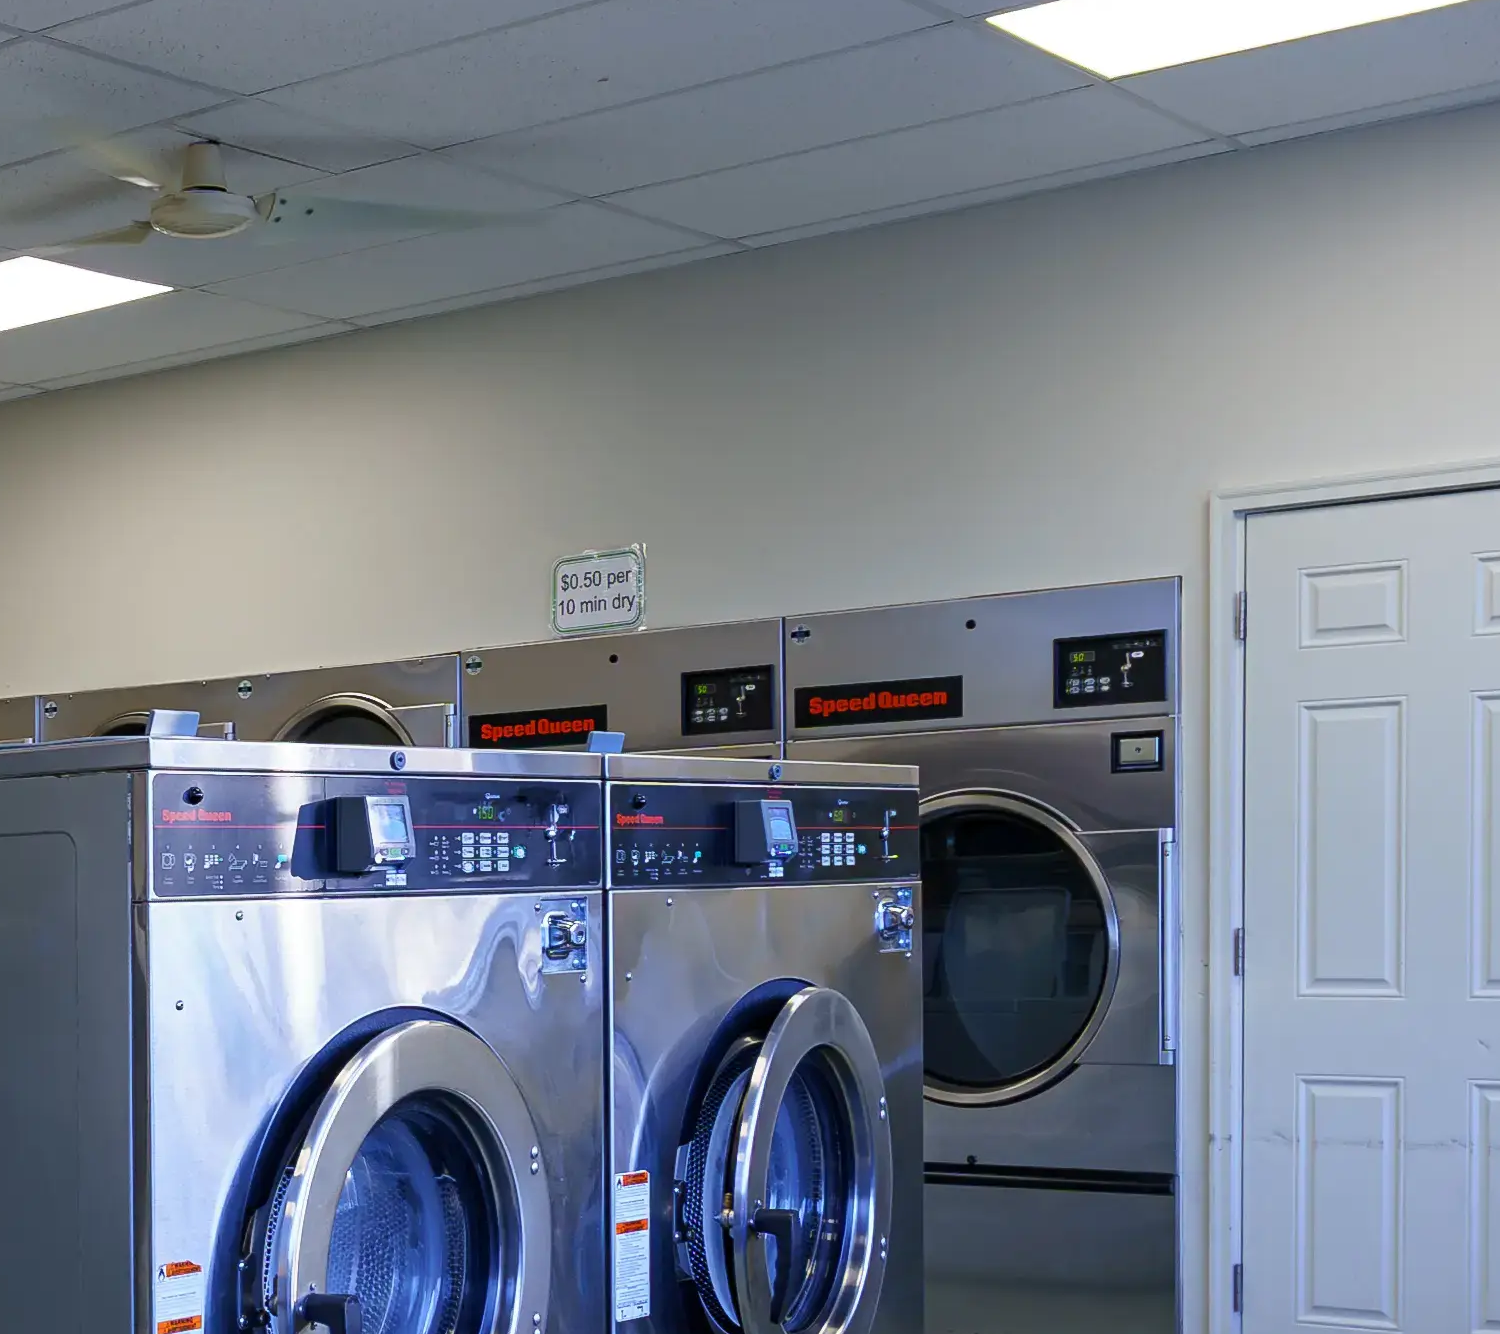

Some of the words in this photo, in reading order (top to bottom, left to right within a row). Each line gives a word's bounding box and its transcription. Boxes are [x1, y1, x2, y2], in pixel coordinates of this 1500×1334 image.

[560, 570, 602, 592] $0.50
[607, 569, 632, 588] per
[558, 598, 576, 616] 10
[580, 595, 607, 614] min
[612, 593, 636, 612] dry
[809, 692, 876, 717] Speed
[878, 690, 948, 708] Queen
[480, 719, 536, 742] Speed
[538, 718, 596, 735] Queen
[162, 809, 197, 824] Speed
[198, 808, 232, 822] Queen
